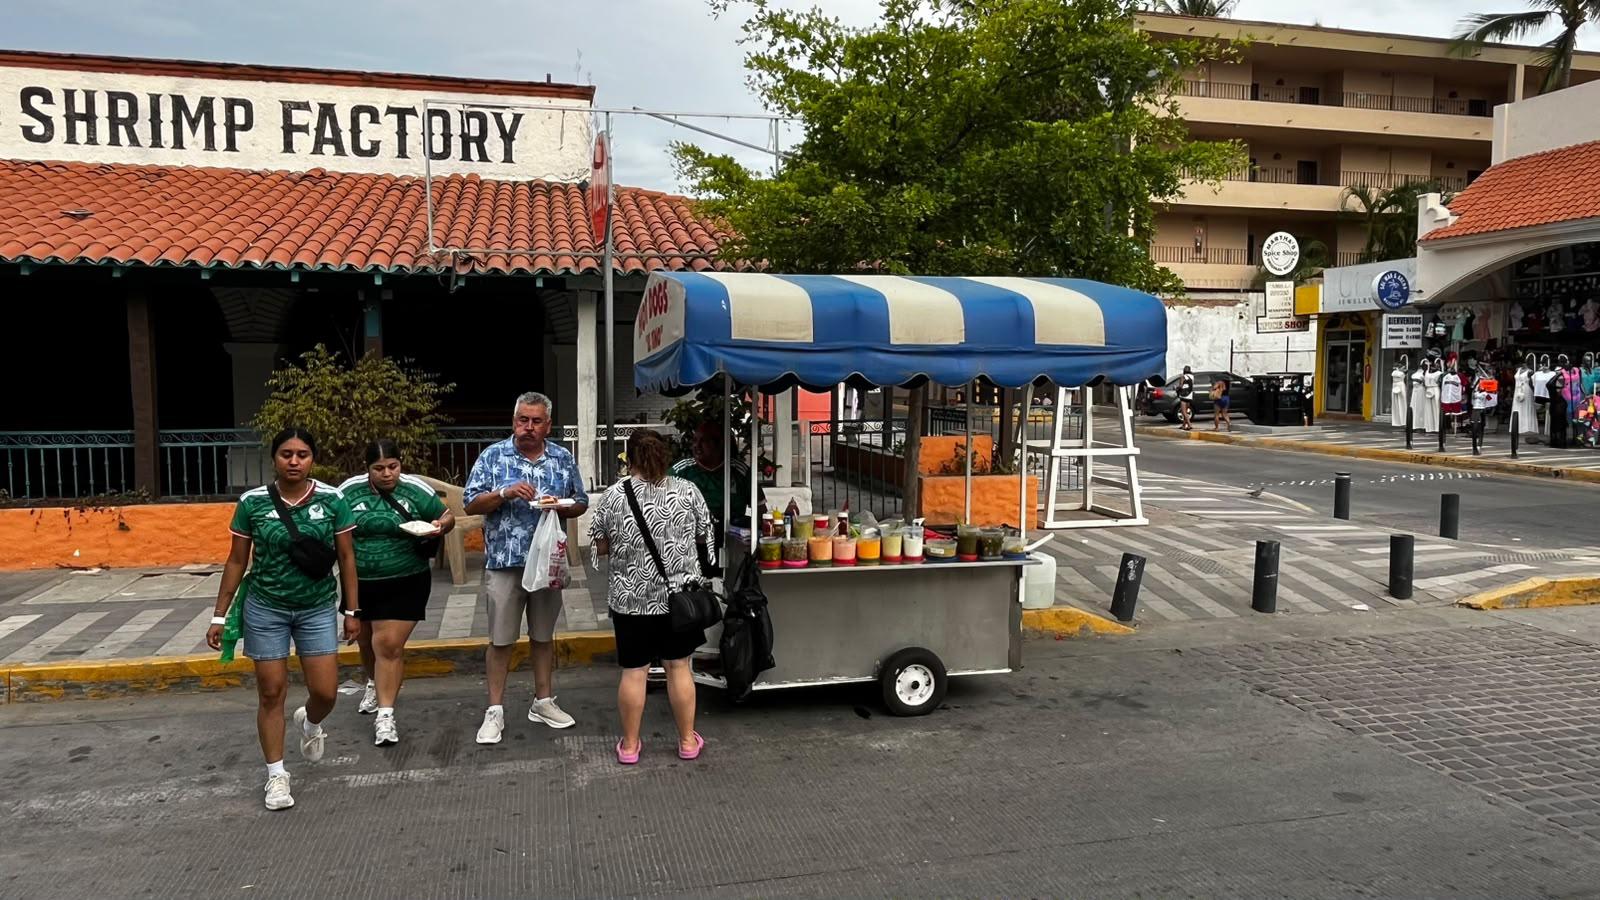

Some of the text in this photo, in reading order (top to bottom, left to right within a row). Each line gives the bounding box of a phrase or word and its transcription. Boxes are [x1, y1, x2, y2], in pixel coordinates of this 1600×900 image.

[20, 86, 524, 164] SHRIMP FACTORY
[1266, 235, 1296, 250] MARTHA'S
[648, 280, 668, 319] DOGS
[1284, 321, 1307, 329] SHOP
